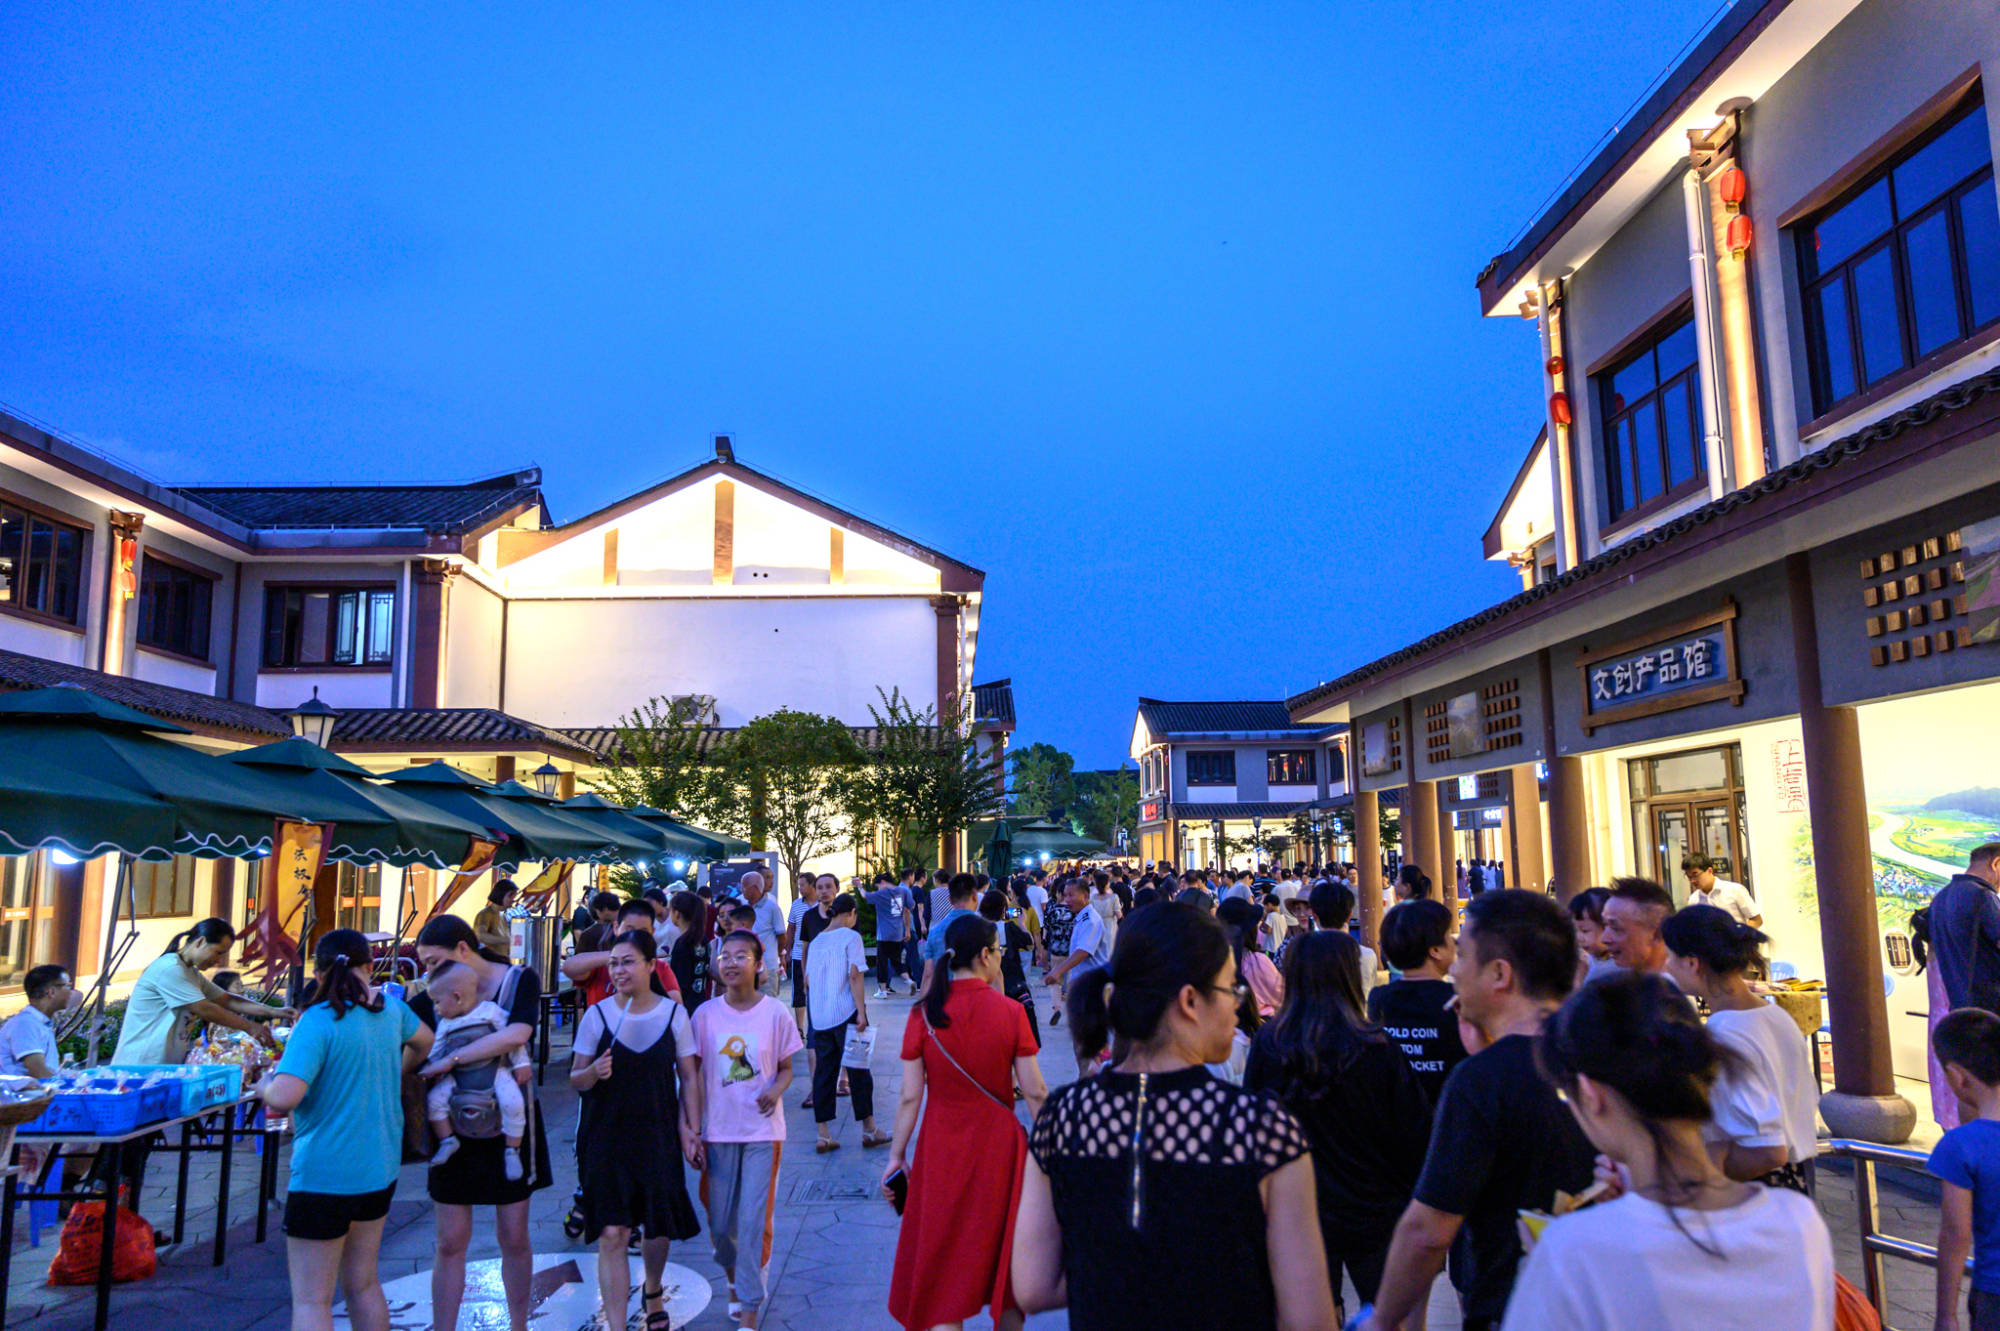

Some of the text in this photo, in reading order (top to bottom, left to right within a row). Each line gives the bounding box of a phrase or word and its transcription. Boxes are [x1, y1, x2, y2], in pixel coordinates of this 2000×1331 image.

[1593, 640, 1707, 700] 文创产品馆
[1411, 1028, 1438, 1038] COIN
